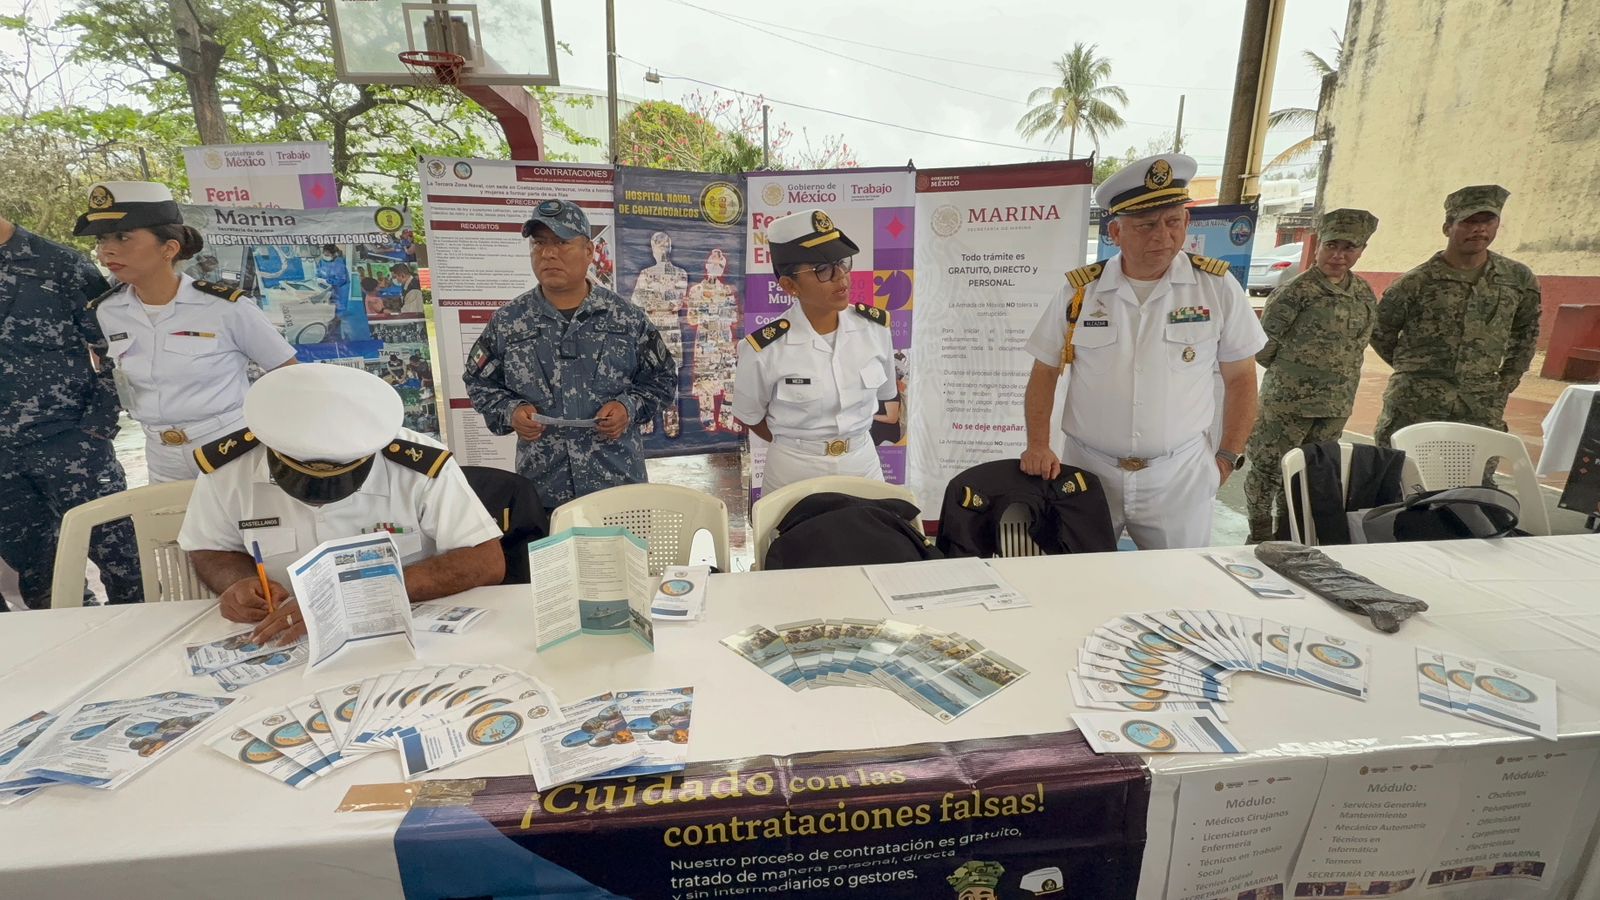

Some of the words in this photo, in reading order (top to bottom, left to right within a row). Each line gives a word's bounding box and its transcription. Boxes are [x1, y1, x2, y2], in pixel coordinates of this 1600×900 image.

[276, 150, 310, 160] Trabajo
[226, 156, 266, 168] México
[534, 168, 608, 178] CONTRATACIONES
[206, 186, 250, 202] Feria
[851, 184, 892, 194] Trabajo
[625, 191, 665, 202] HOSPITAL
[667, 194, 692, 204] NAVAL
[788, 190, 836, 203] México
[214, 208, 296, 226] Marina
[619, 204, 629, 214] DE
[632, 205, 699, 218] COATZACOALCOS
[968, 205, 1061, 223] MARINA
[208, 234, 259, 245] HOSPITAL
[260, 235, 295, 245] NAVAL
[296, 236, 308, 245] DE
[310, 234, 389, 245] COATZACOALCOS
[948, 266, 991, 275] GRATUITO,
[1032, 266, 1038, 274] y
[975, 423, 990, 432] deje
[992, 424, 1026, 432] engañar.
[241, 519, 278, 527] CASTELLANOS
[1502, 770, 1549, 781] Módulo:
[1368, 784, 1417, 792] Módulo:
[1488, 790, 1526, 799] Choferes
[520, 768, 774, 829] ¡Cuidado
[789, 773, 850, 793] con
[857, 768, 907, 786] las
[1226, 796, 1276, 809] Módulo:
[1482, 802, 1532, 812] Peluqueros
[663, 801, 931, 848] contrataciones
[939, 783, 1045, 823] falsas!
[1205, 817, 1245, 827] Médicos
[1247, 810, 1289, 822] Cirujanos
[1203, 829, 1258, 842] Licenciatura
[1472, 828, 1520, 839] Carpinteros
[670, 858, 736, 871] Nuestro
[741, 852, 805, 867] proceso
[809, 849, 829, 860] de
[833, 836, 934, 859] contratación
[939, 838, 955, 847] es
[959, 827, 1022, 846] gratuito,
[1201, 840, 1251, 853] Enfermería
[1466, 840, 1516, 851] Electricistas
[1200, 856, 1237, 867] Técnicos
[1252, 845, 1282, 856] Trabajo
[1440, 854, 1487, 866] SECRETARÍA
[670, 872, 731, 889] tratado
[736, 870, 757, 882] de
[762, 865, 822, 880] manera
[827, 856, 898, 872] personal,
[902, 849, 956, 862] directa
[1197, 867, 1224, 878] Social
[1306, 870, 1361, 878] SECRETARÍA
[1378, 868, 1415, 877] MARINA
[686, 890, 708, 900] sin
[714, 876, 830, 898] intermediarios
[834, 877, 844, 886] o
[848, 869, 918, 888] gestores.
[1196, 879, 1226, 892] Técnico
[1231, 882, 1243, 891] DE
[1244, 874, 1278, 887] MARINA
